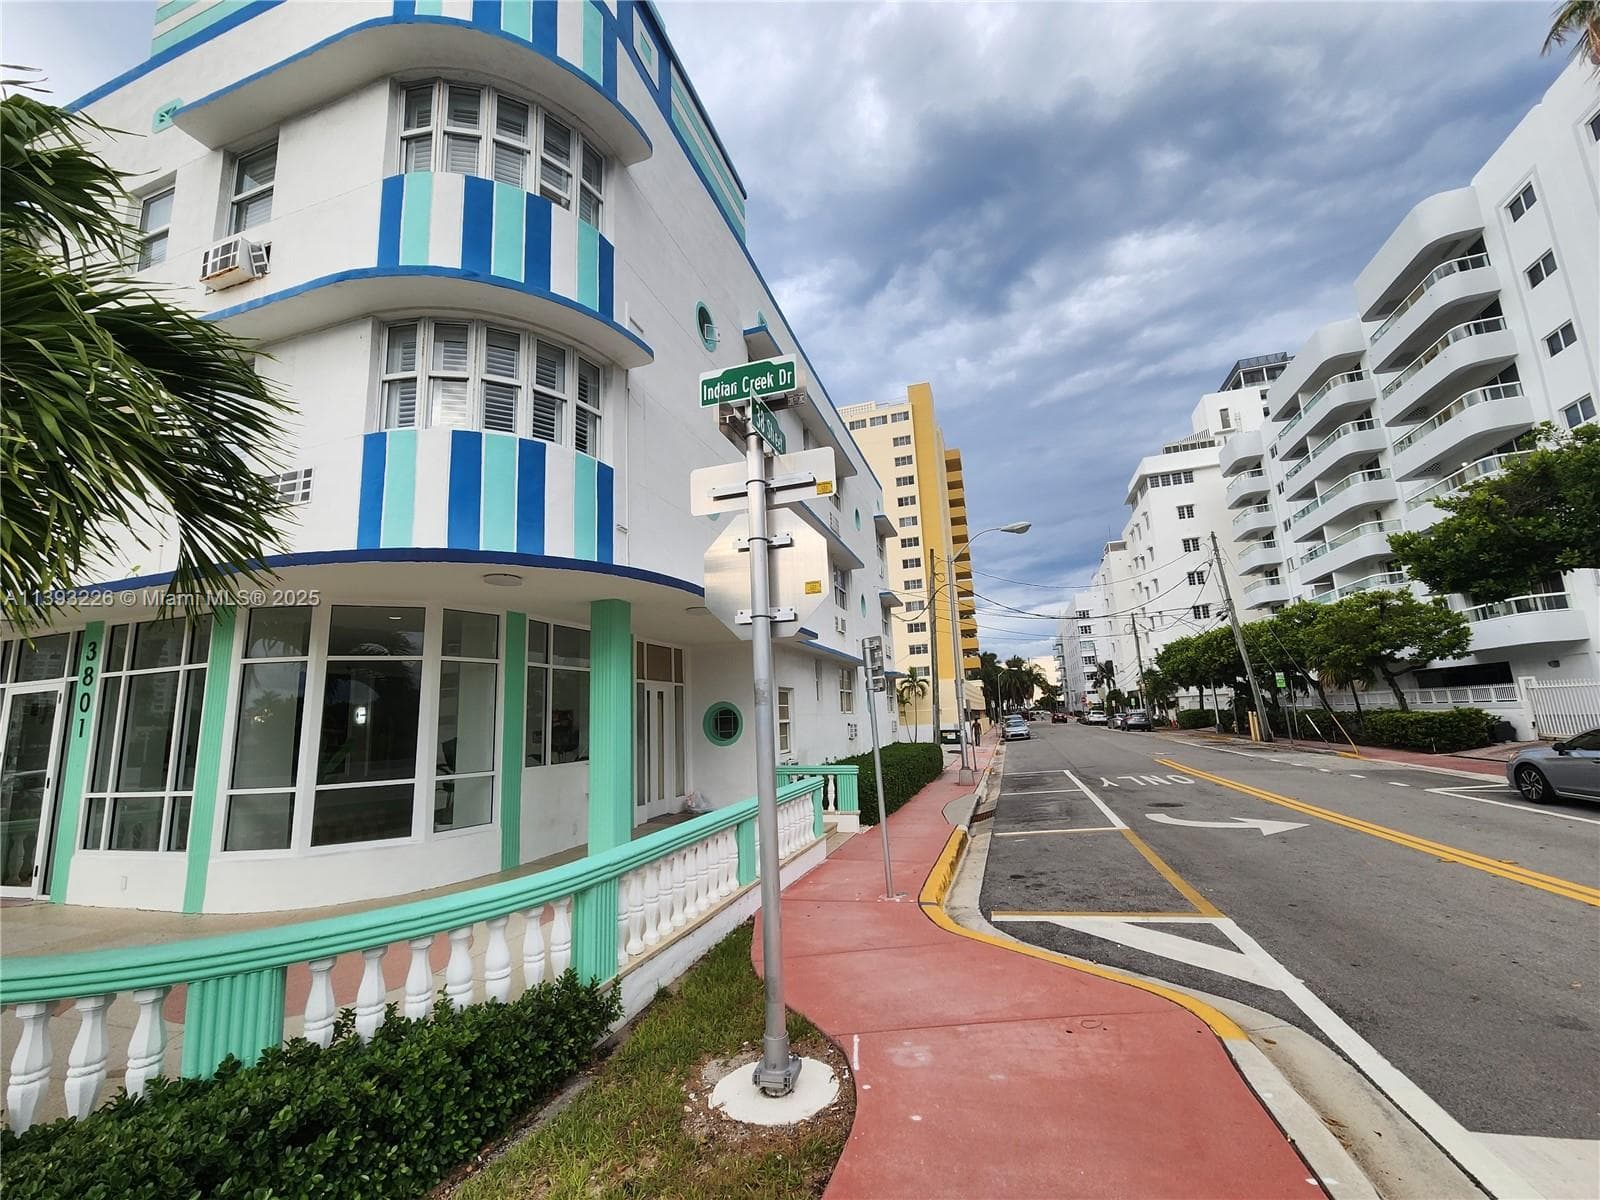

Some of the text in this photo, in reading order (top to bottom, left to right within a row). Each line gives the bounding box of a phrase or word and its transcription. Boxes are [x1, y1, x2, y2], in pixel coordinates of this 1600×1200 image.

[703, 368, 792, 401] Indian Creek Dr
[78, 641, 98, 738] 3801
[1100, 774, 1196, 787] ONLY
